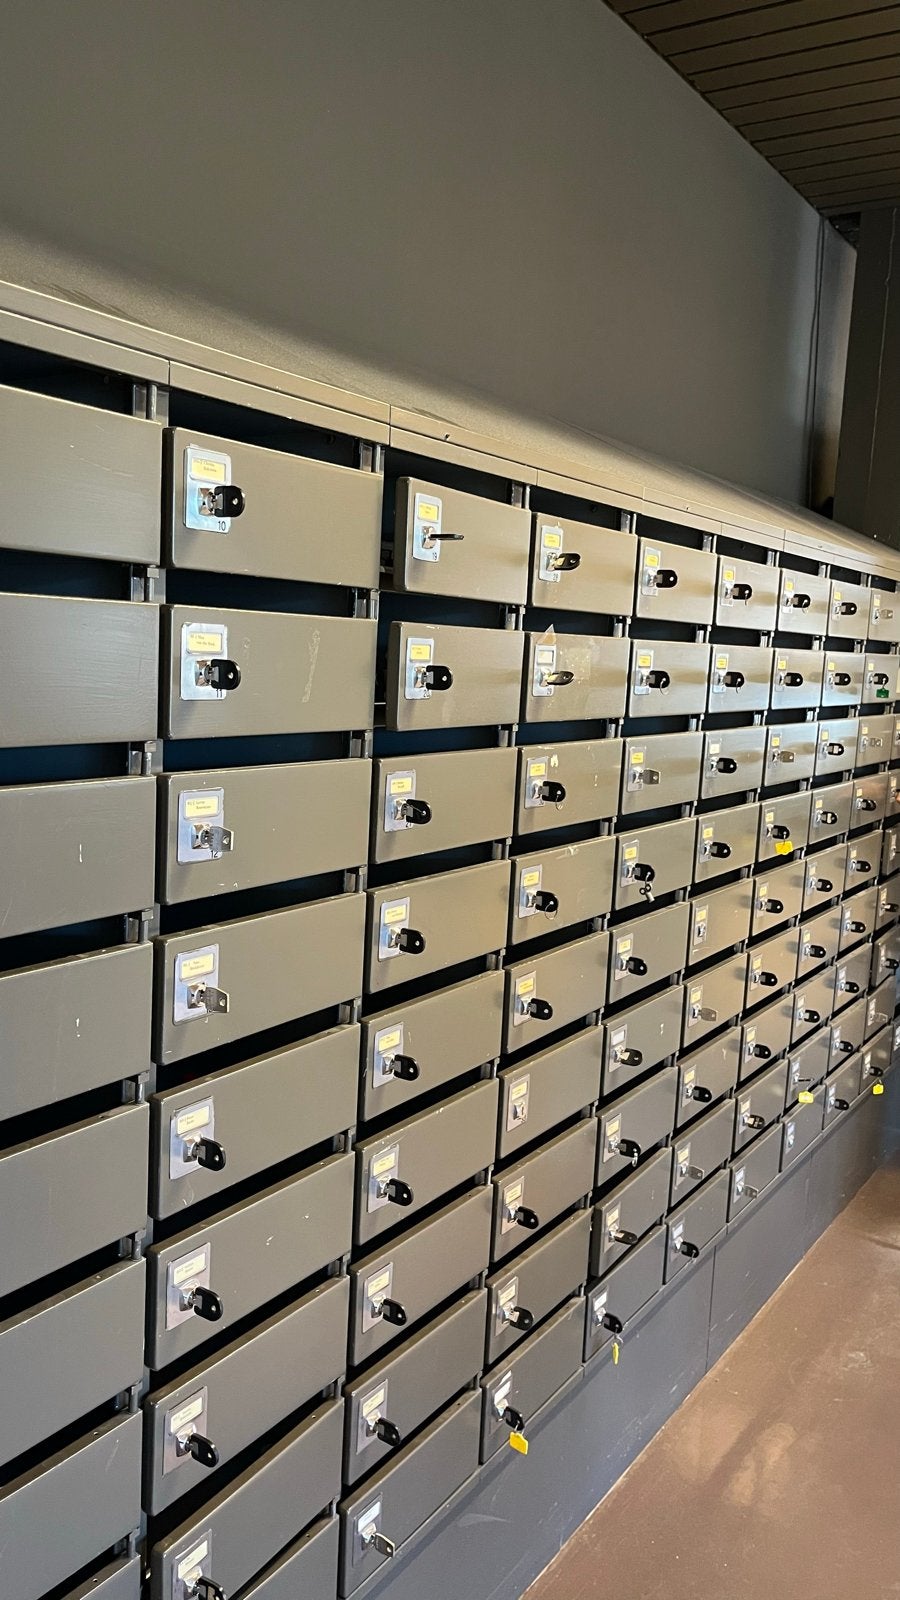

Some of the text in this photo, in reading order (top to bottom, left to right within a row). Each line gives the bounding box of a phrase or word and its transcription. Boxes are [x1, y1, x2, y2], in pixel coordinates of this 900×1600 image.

[217, 520, 226, 531] 10
[215, 688, 223, 698] 11
[210, 849, 218, 859] 12
